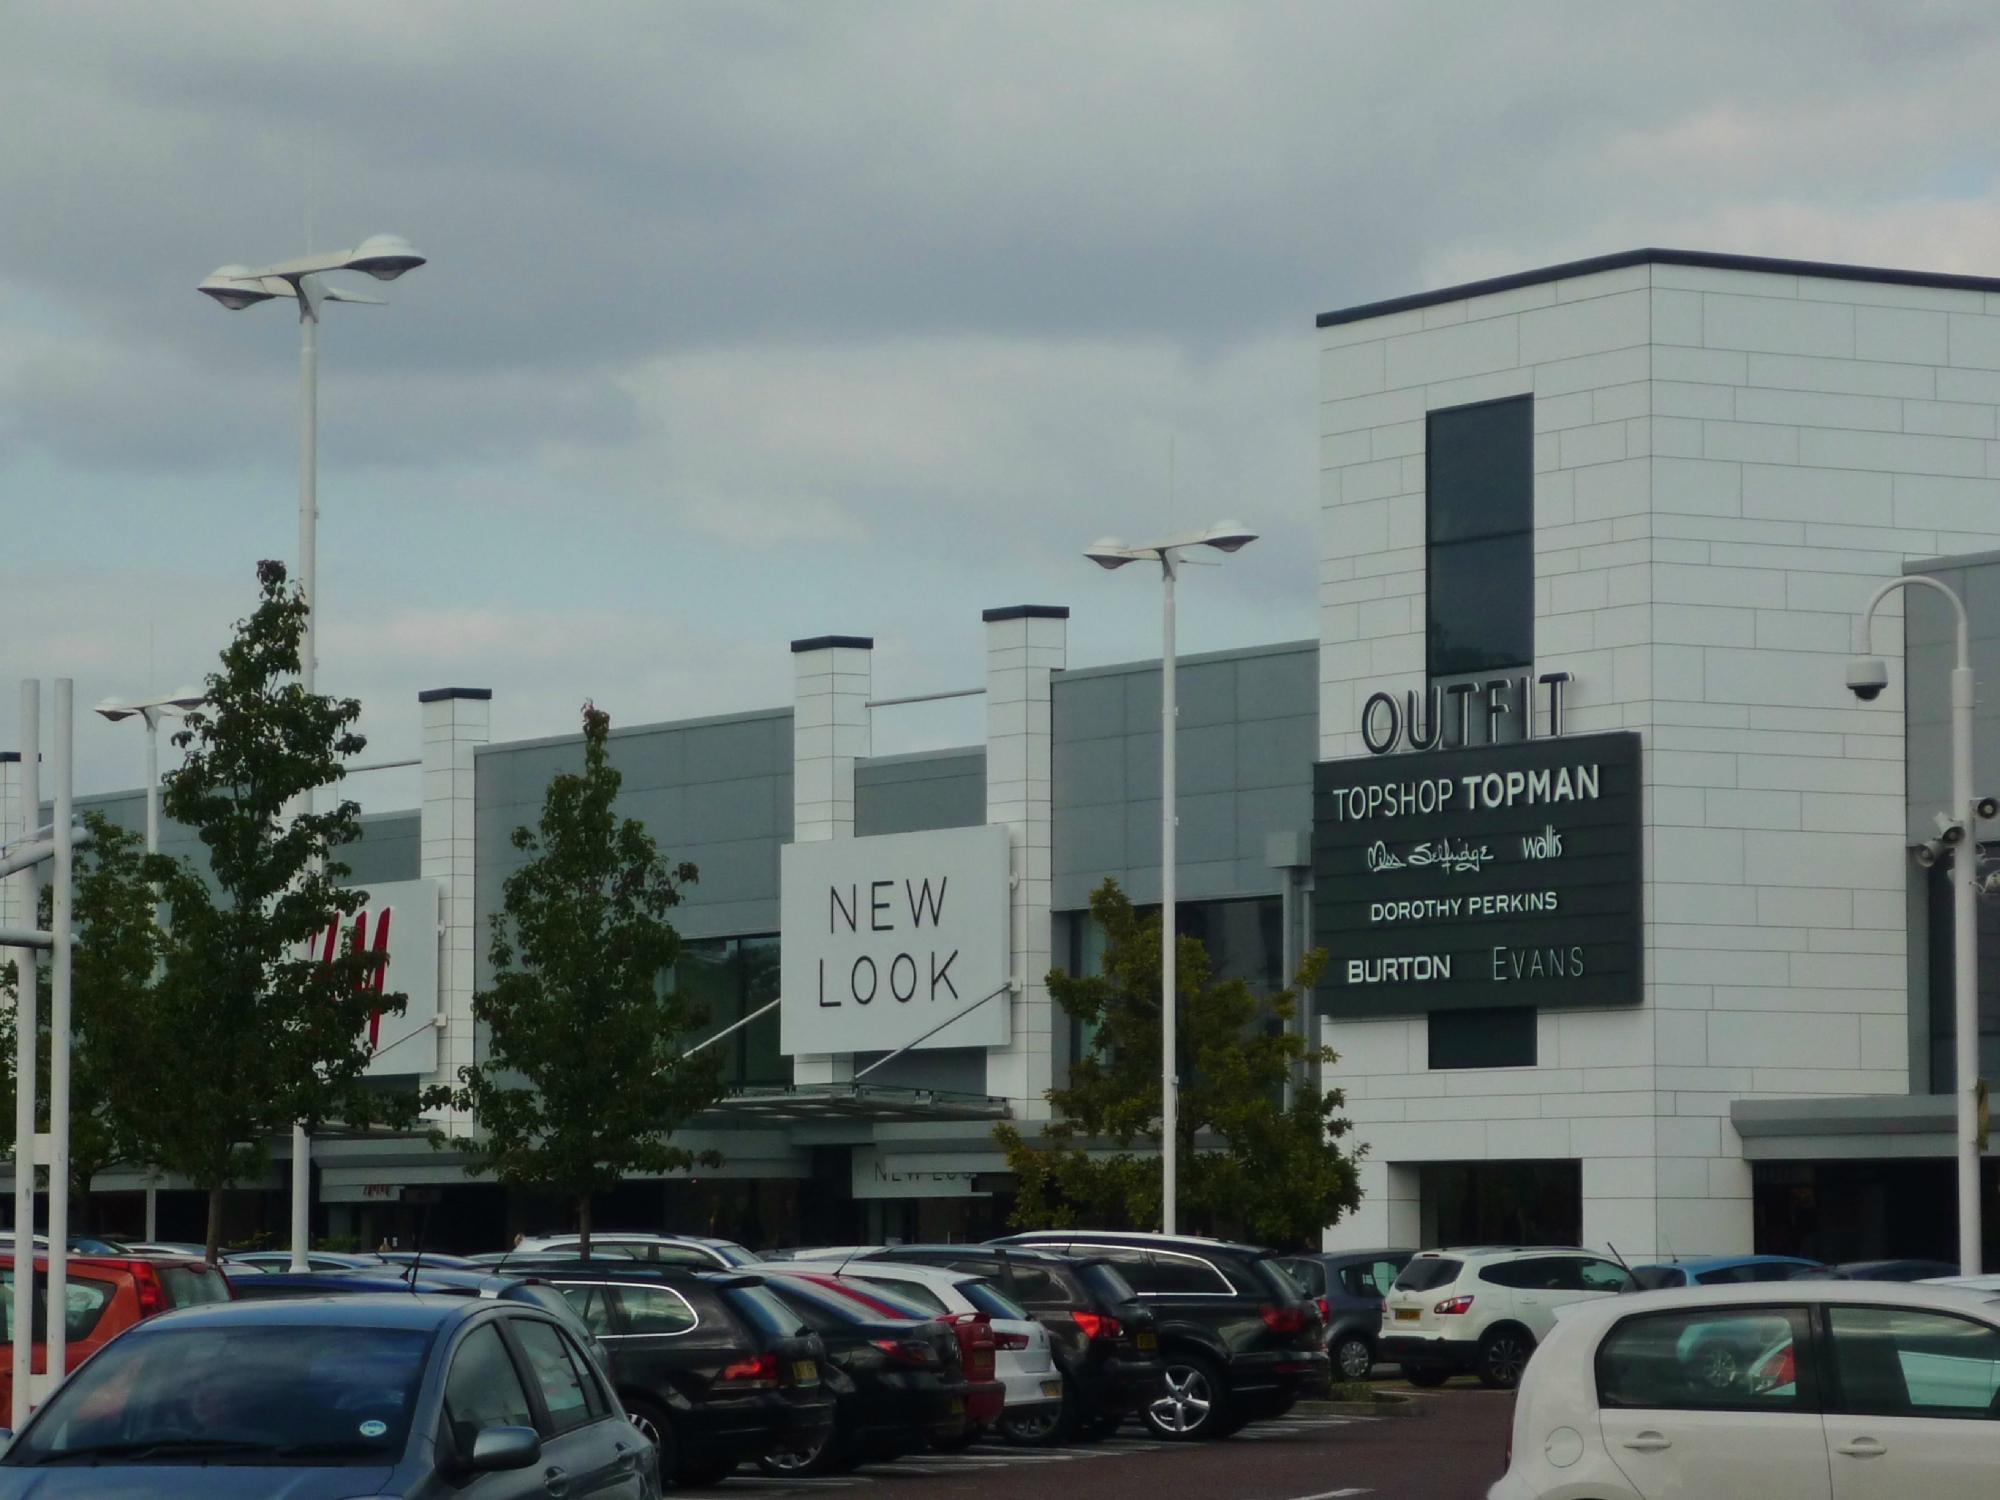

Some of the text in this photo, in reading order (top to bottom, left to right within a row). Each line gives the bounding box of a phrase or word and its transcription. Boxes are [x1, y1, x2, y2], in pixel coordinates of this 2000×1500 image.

[1362, 672, 1574, 754] OUTFIT
[1333, 764, 1600, 821] TOPSHOP TOPMAN
[831, 876, 947, 934] NEW
[1371, 891, 1558, 922] DOROTHY PERKINS
[819, 949, 959, 1007] LOOK
[1348, 954, 1451, 984] BURTON
[1493, 946, 1584, 981] EVANS
